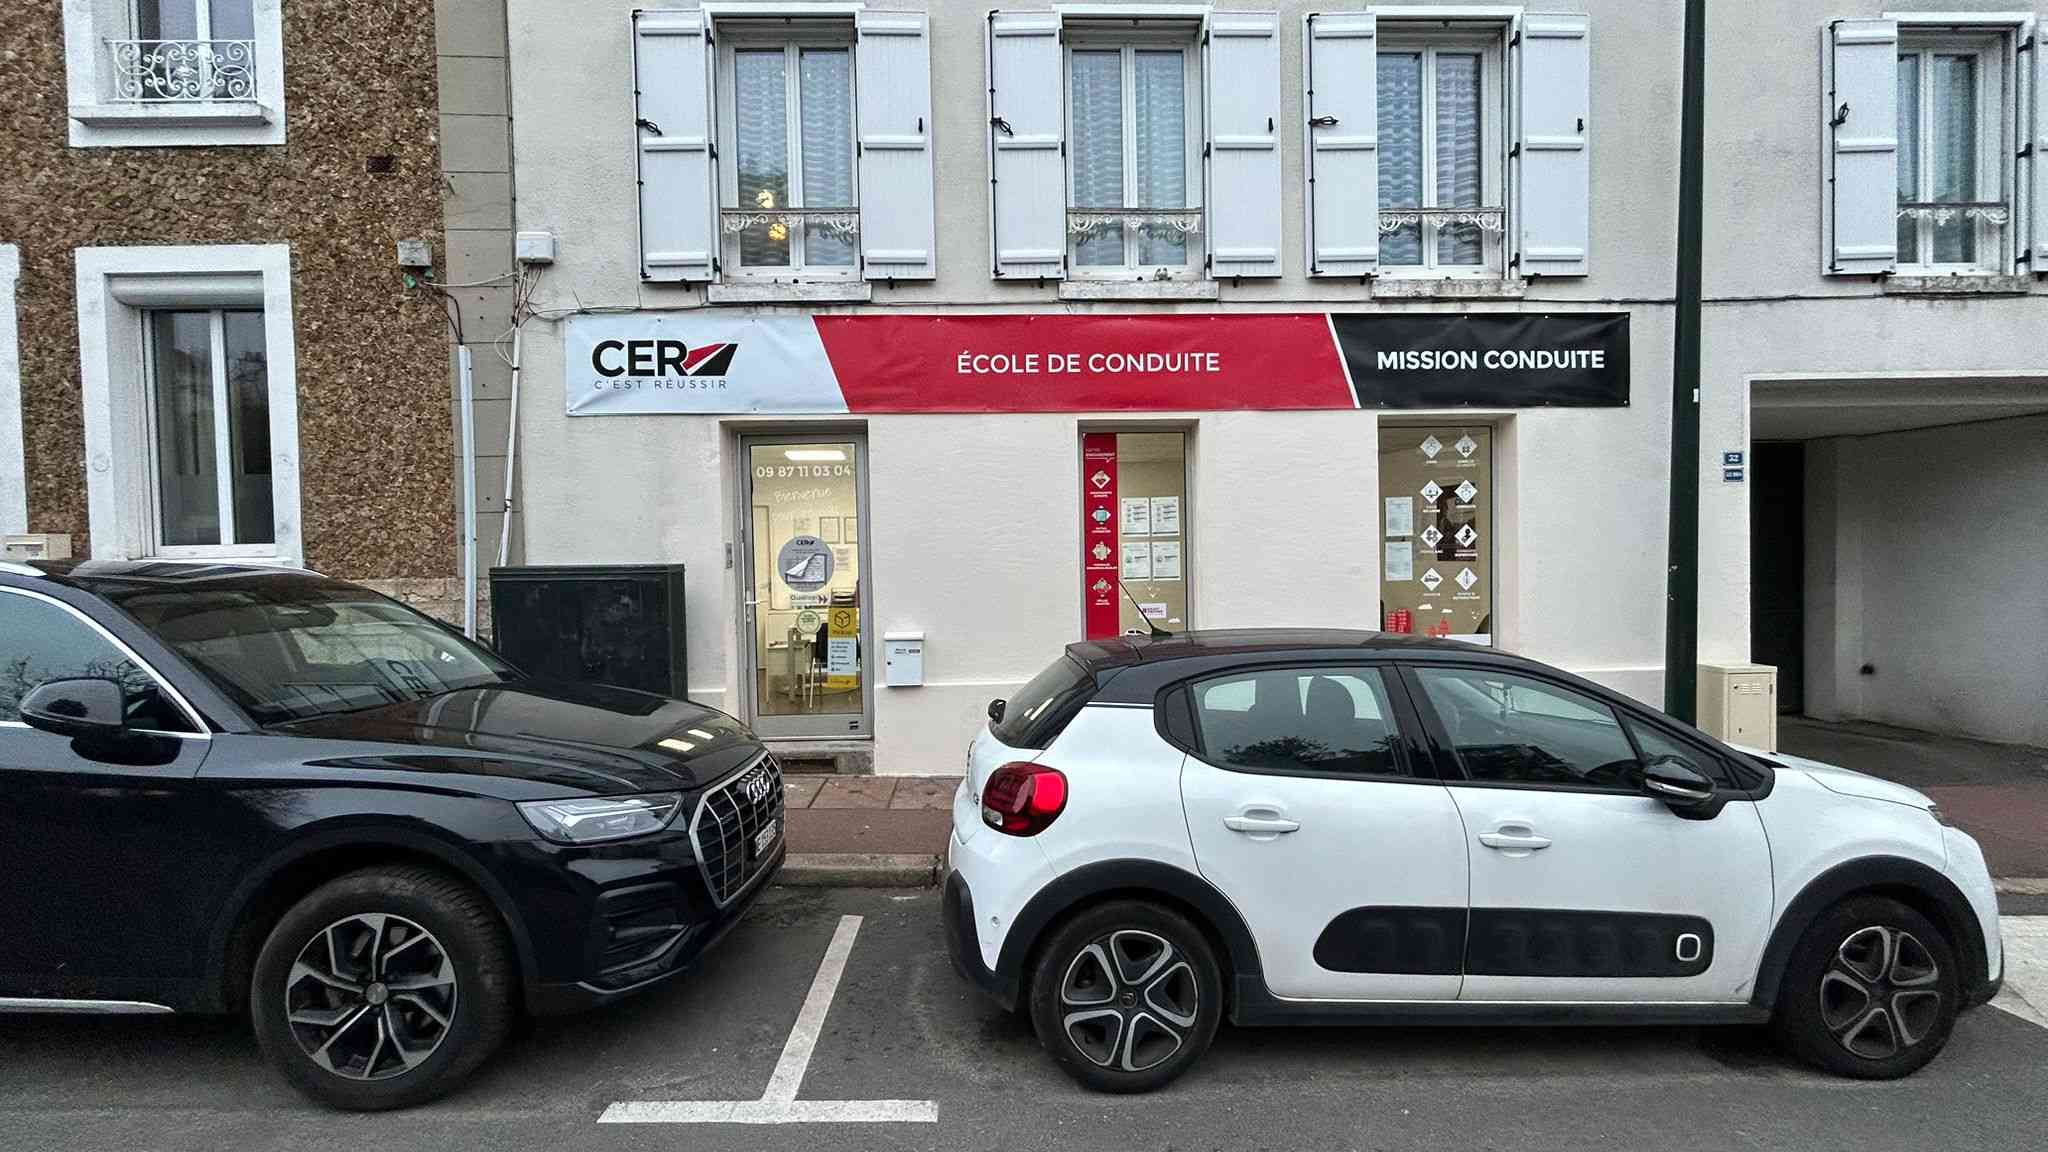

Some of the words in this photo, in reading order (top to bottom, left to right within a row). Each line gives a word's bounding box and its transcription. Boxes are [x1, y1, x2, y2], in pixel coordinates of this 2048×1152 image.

[592, 340, 688, 377] CER
[957, 351, 1039, 373] ÉCOLE
[1047, 354, 1081, 373] DE
[1088, 353, 1220, 372] CONDUITE
[1377, 351, 1477, 370] MISSION
[1484, 350, 1605, 369] CONDUITE
[594, 380, 642, 390] C'EST
[655, 379, 728, 389] RÉUSSIR
[756, 466, 774, 477] 09
[778, 466, 794, 477] 87
[798, 466, 809, 477] 11
[813, 465, 831, 477] 03
[834, 464, 851, 476] 04
